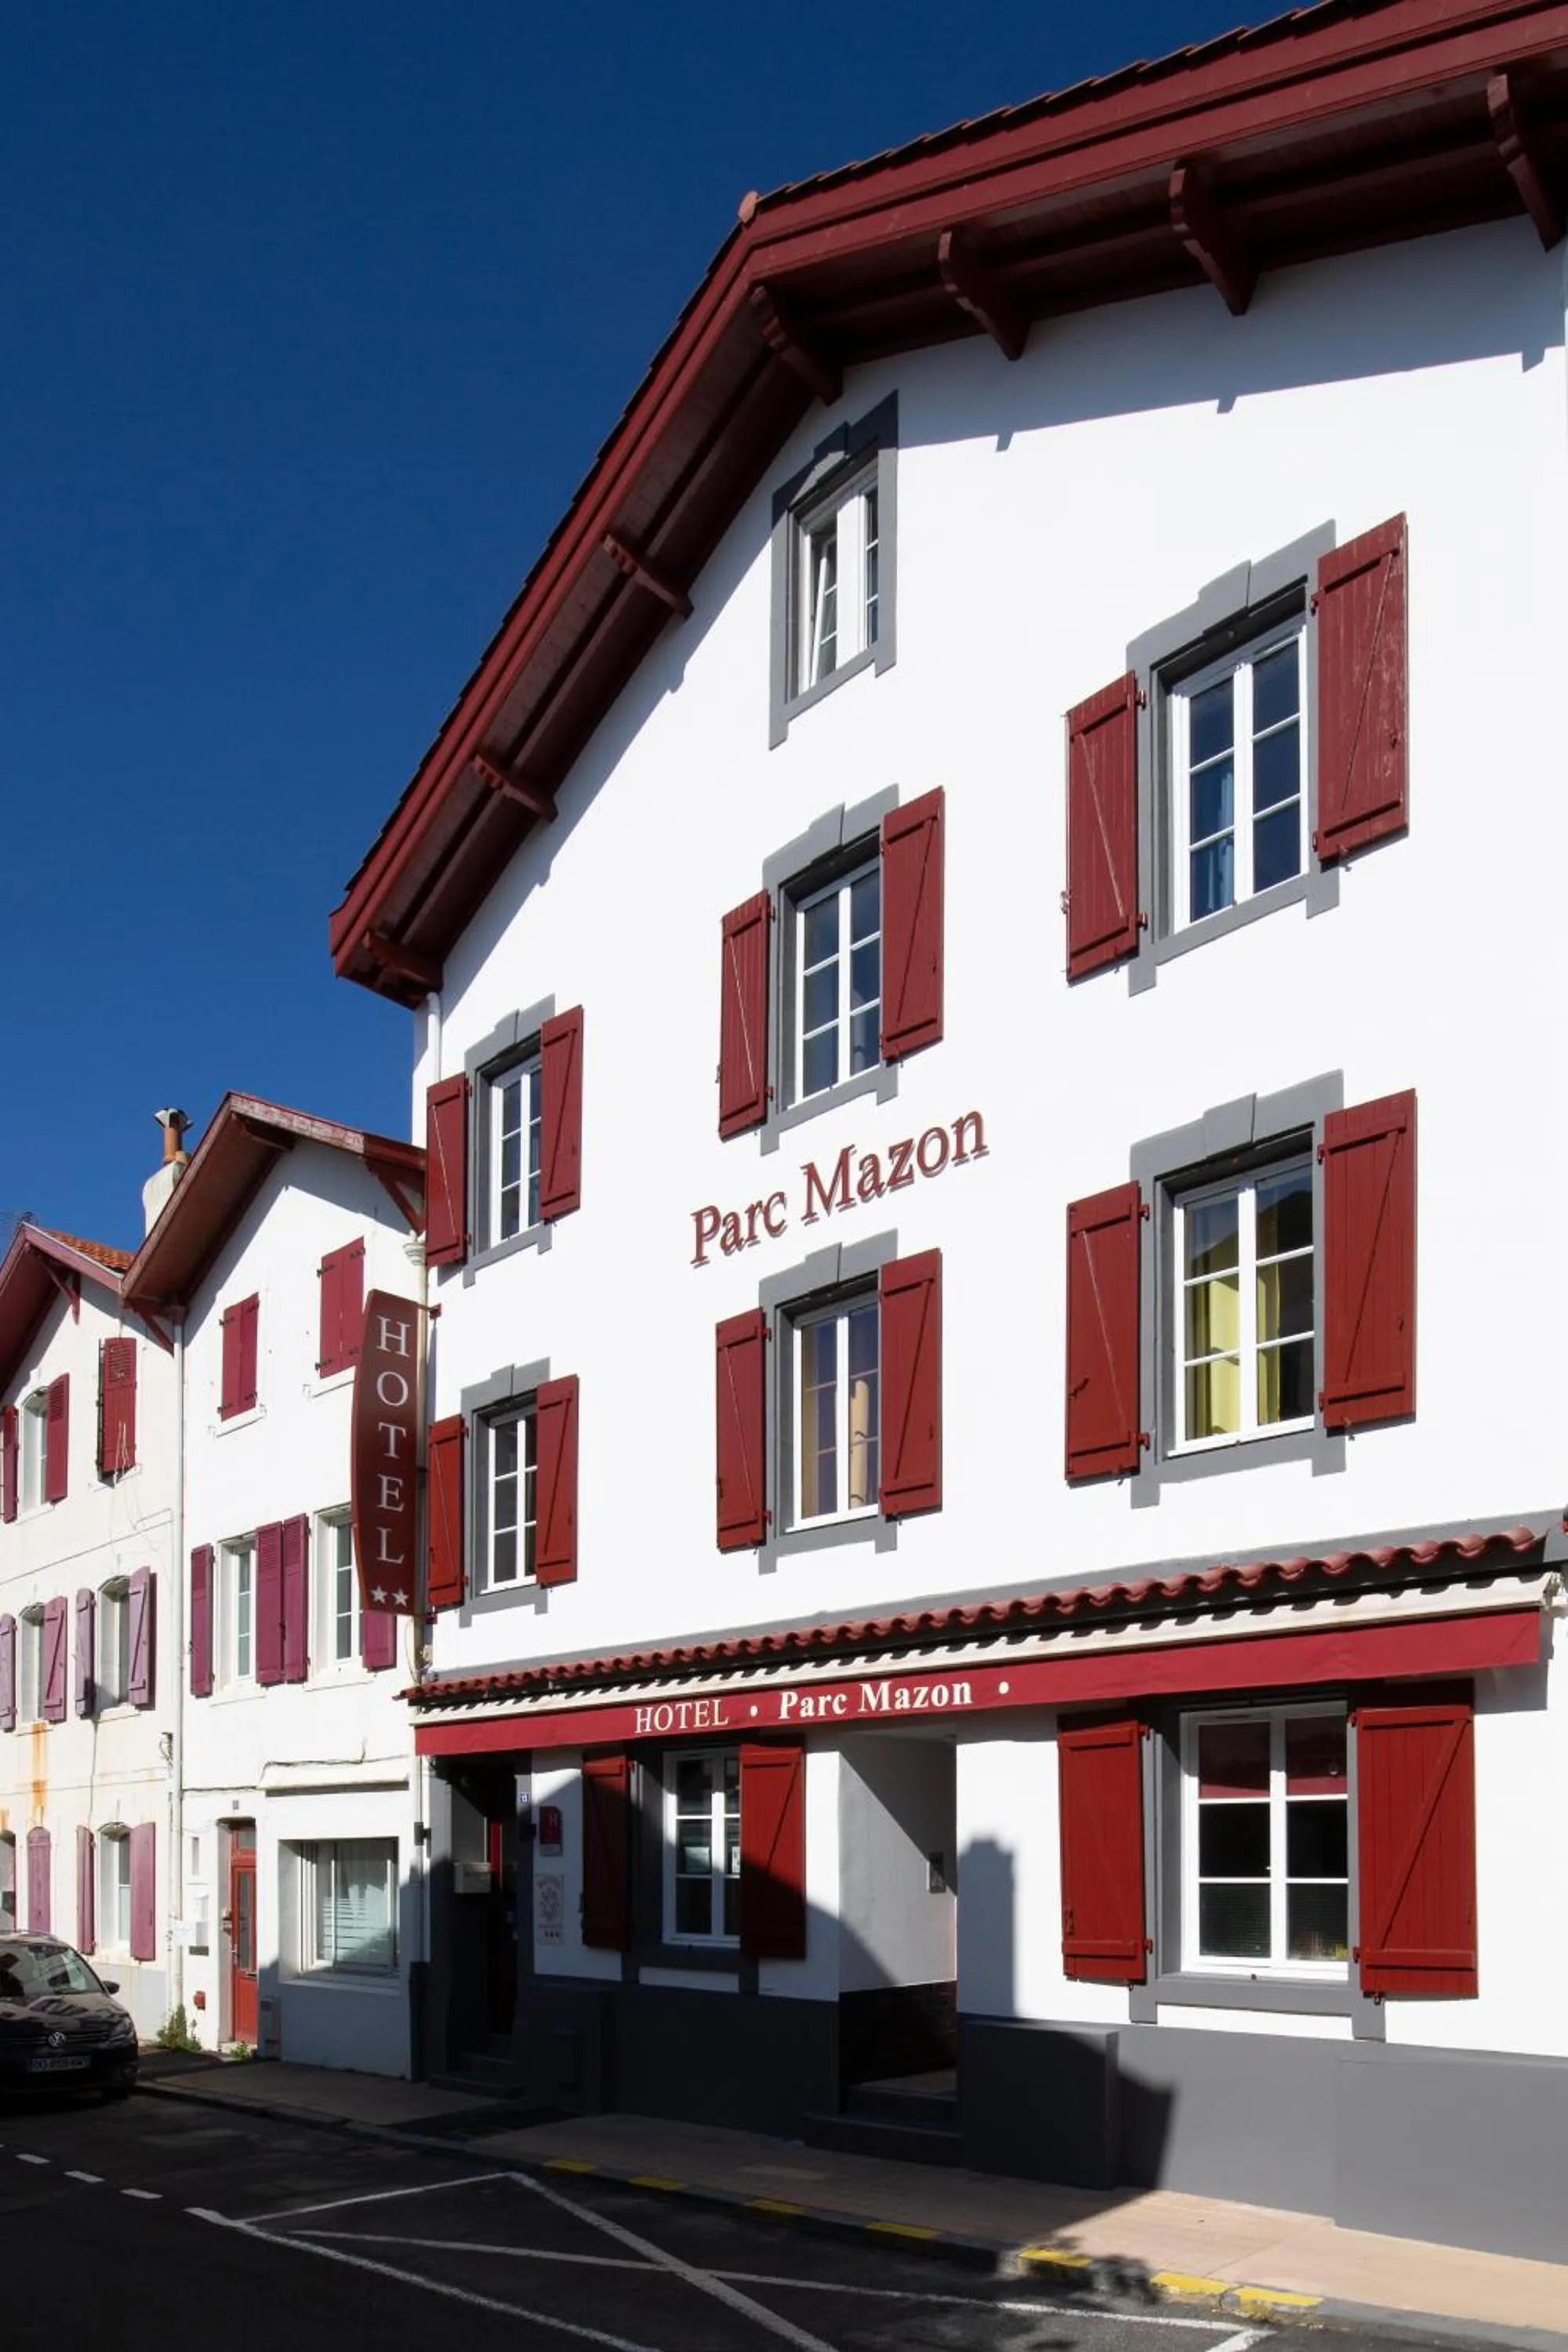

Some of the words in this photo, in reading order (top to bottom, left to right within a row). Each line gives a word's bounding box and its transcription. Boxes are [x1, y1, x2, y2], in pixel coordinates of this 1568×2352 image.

[690, 1191, 787, 1266] Parc
[800, 1110, 989, 1222] Mazon
[376, 1315, 411, 1564] HOTEL
[635, 1699, 728, 1733] HOTEL
[778, 1691, 848, 1719] Parc
[858, 1681, 972, 1712] Mazon
